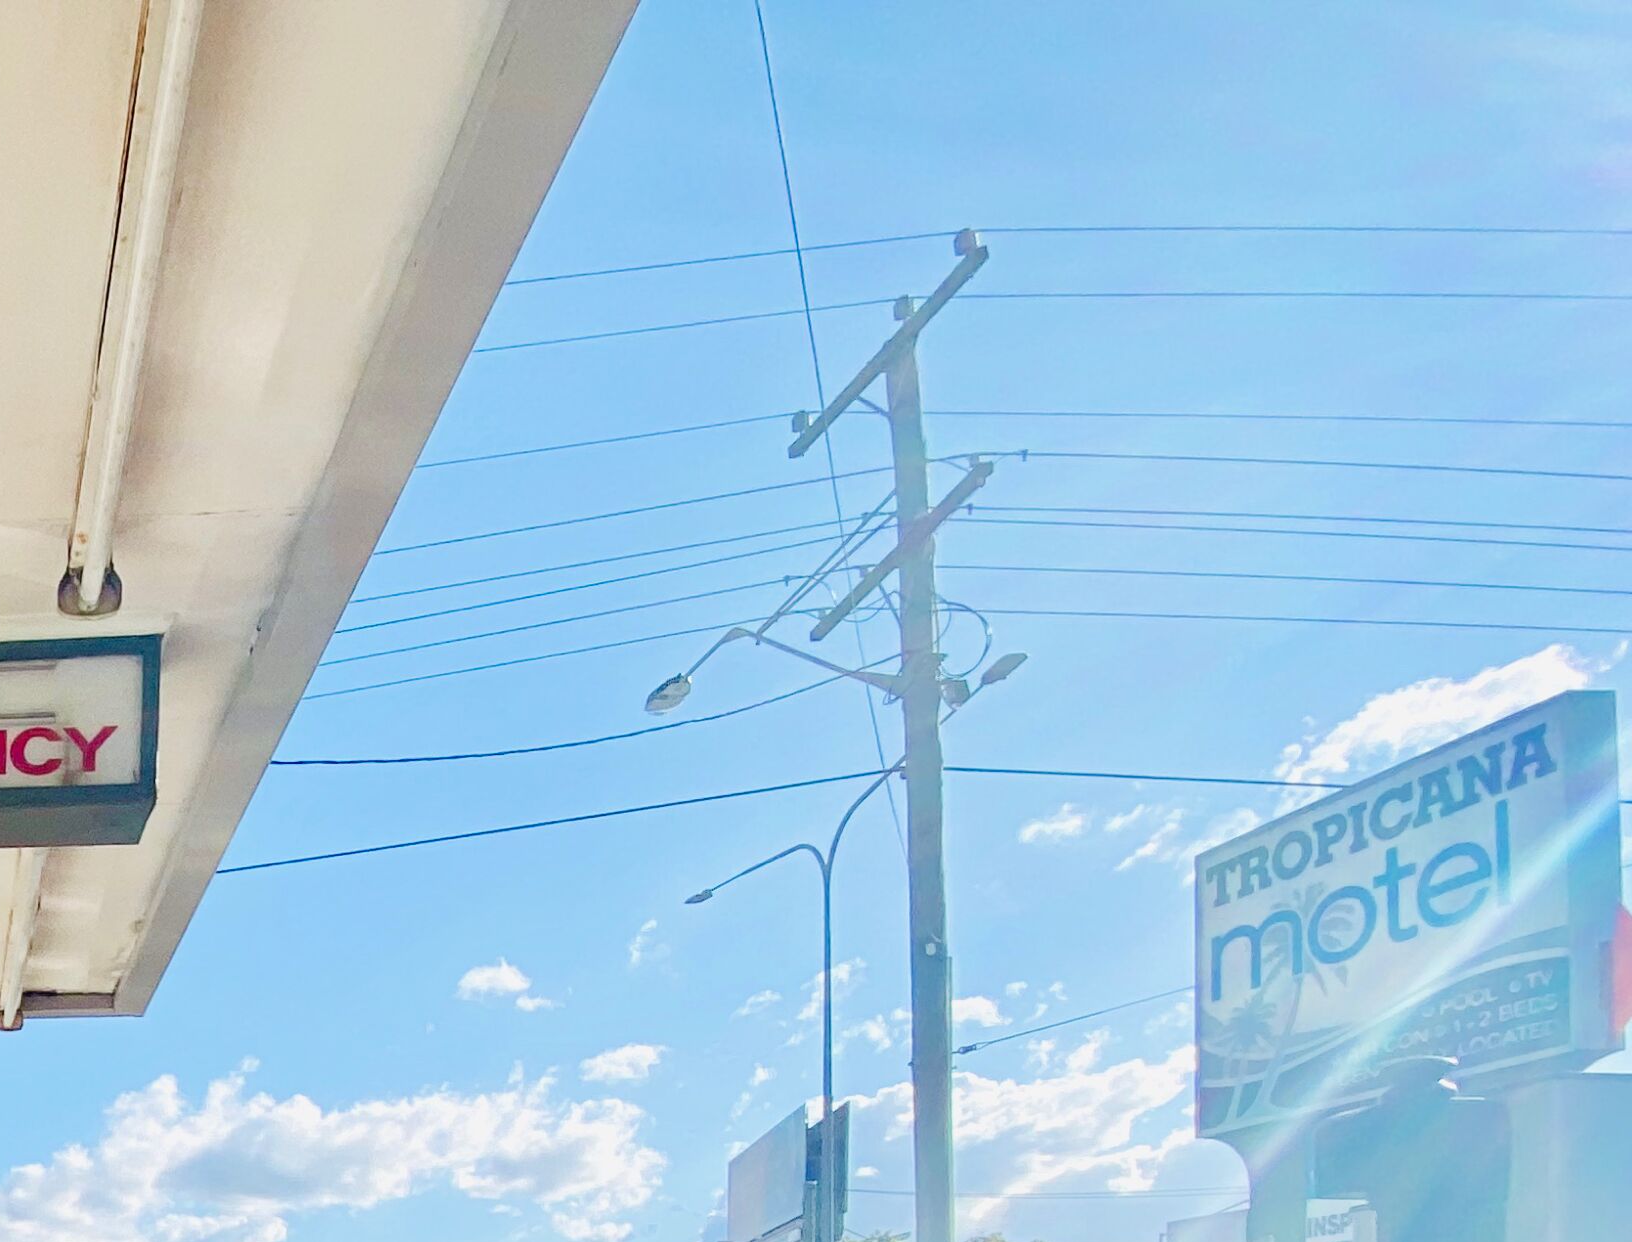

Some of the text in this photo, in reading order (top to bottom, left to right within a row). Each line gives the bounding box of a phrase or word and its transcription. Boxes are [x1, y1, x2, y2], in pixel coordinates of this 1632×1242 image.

[1206, 723, 1558, 908] TROPICANA
[1211, 800, 1511, 1002] motel
[1526, 970, 1553, 988] TV
[1440, 988, 1498, 1015] POOL
[1499, 994, 1557, 1023] BEDS
